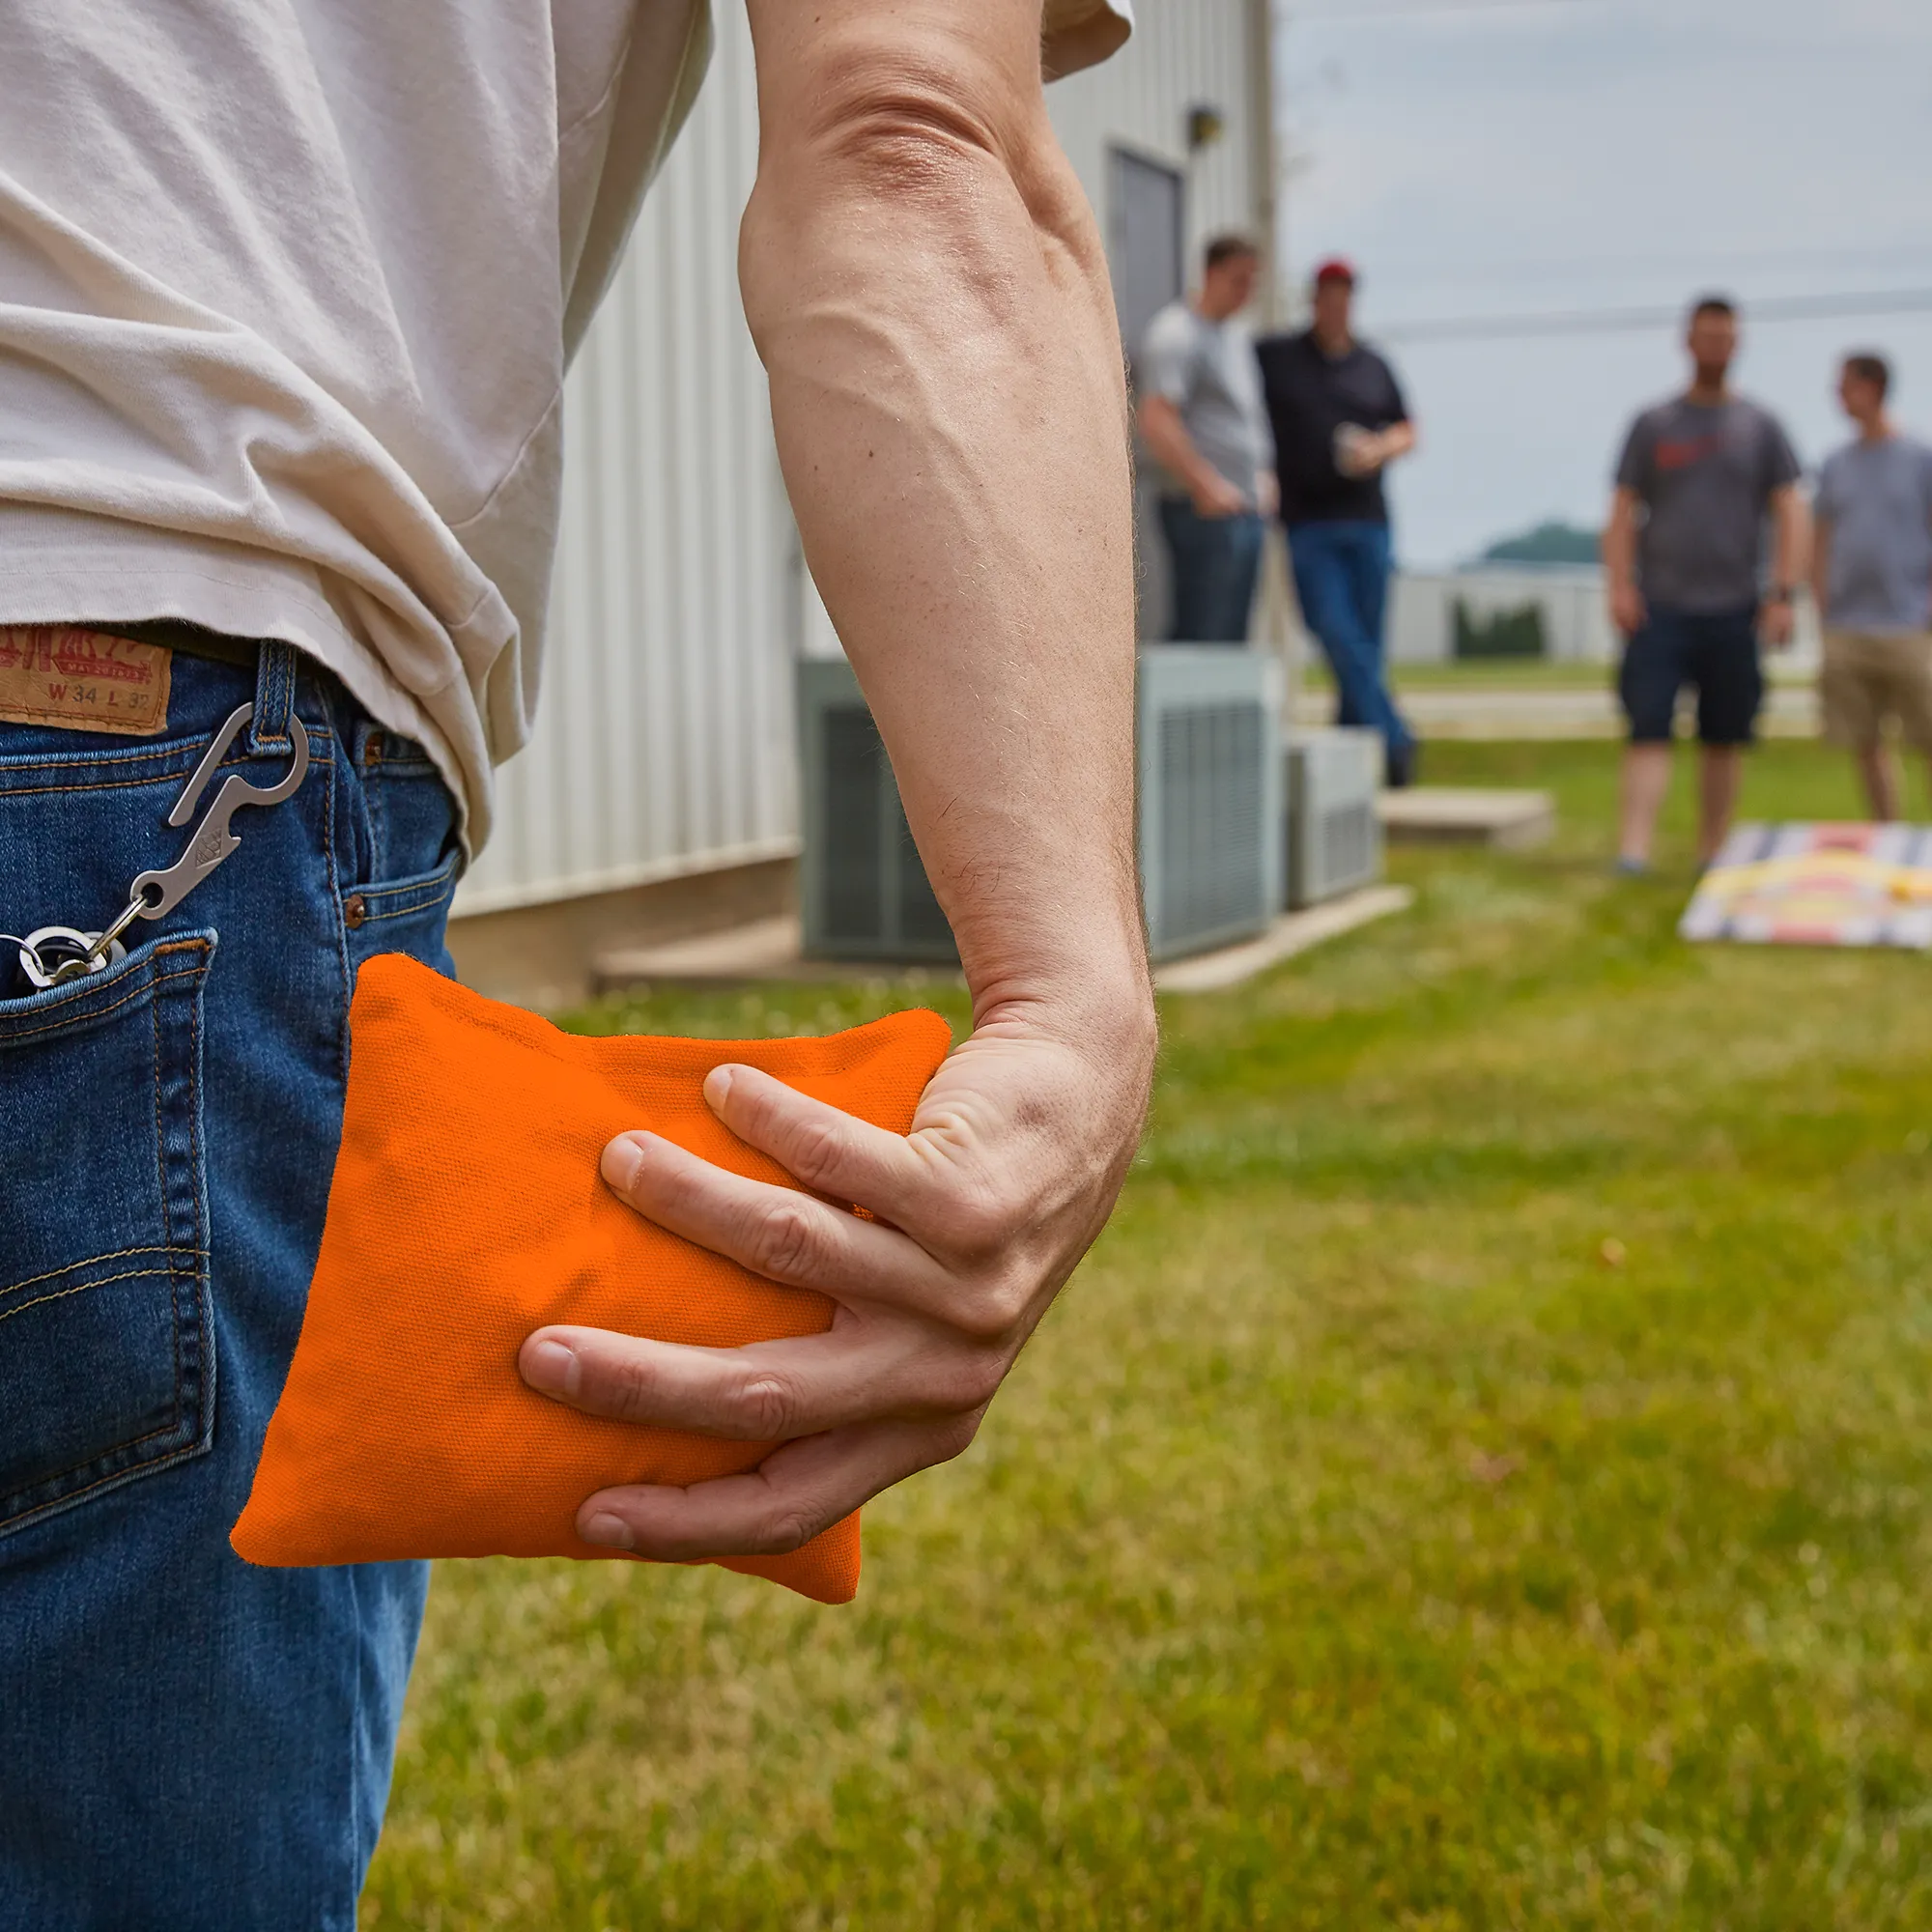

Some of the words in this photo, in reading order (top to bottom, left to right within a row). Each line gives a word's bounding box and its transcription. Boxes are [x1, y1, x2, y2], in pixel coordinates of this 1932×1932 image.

[67, 663, 89, 673] MAY
[49, 683, 68, 700] W
[72, 685, 97, 704] 34
[107, 691, 118, 706] L
[128, 692, 149, 710] 32
